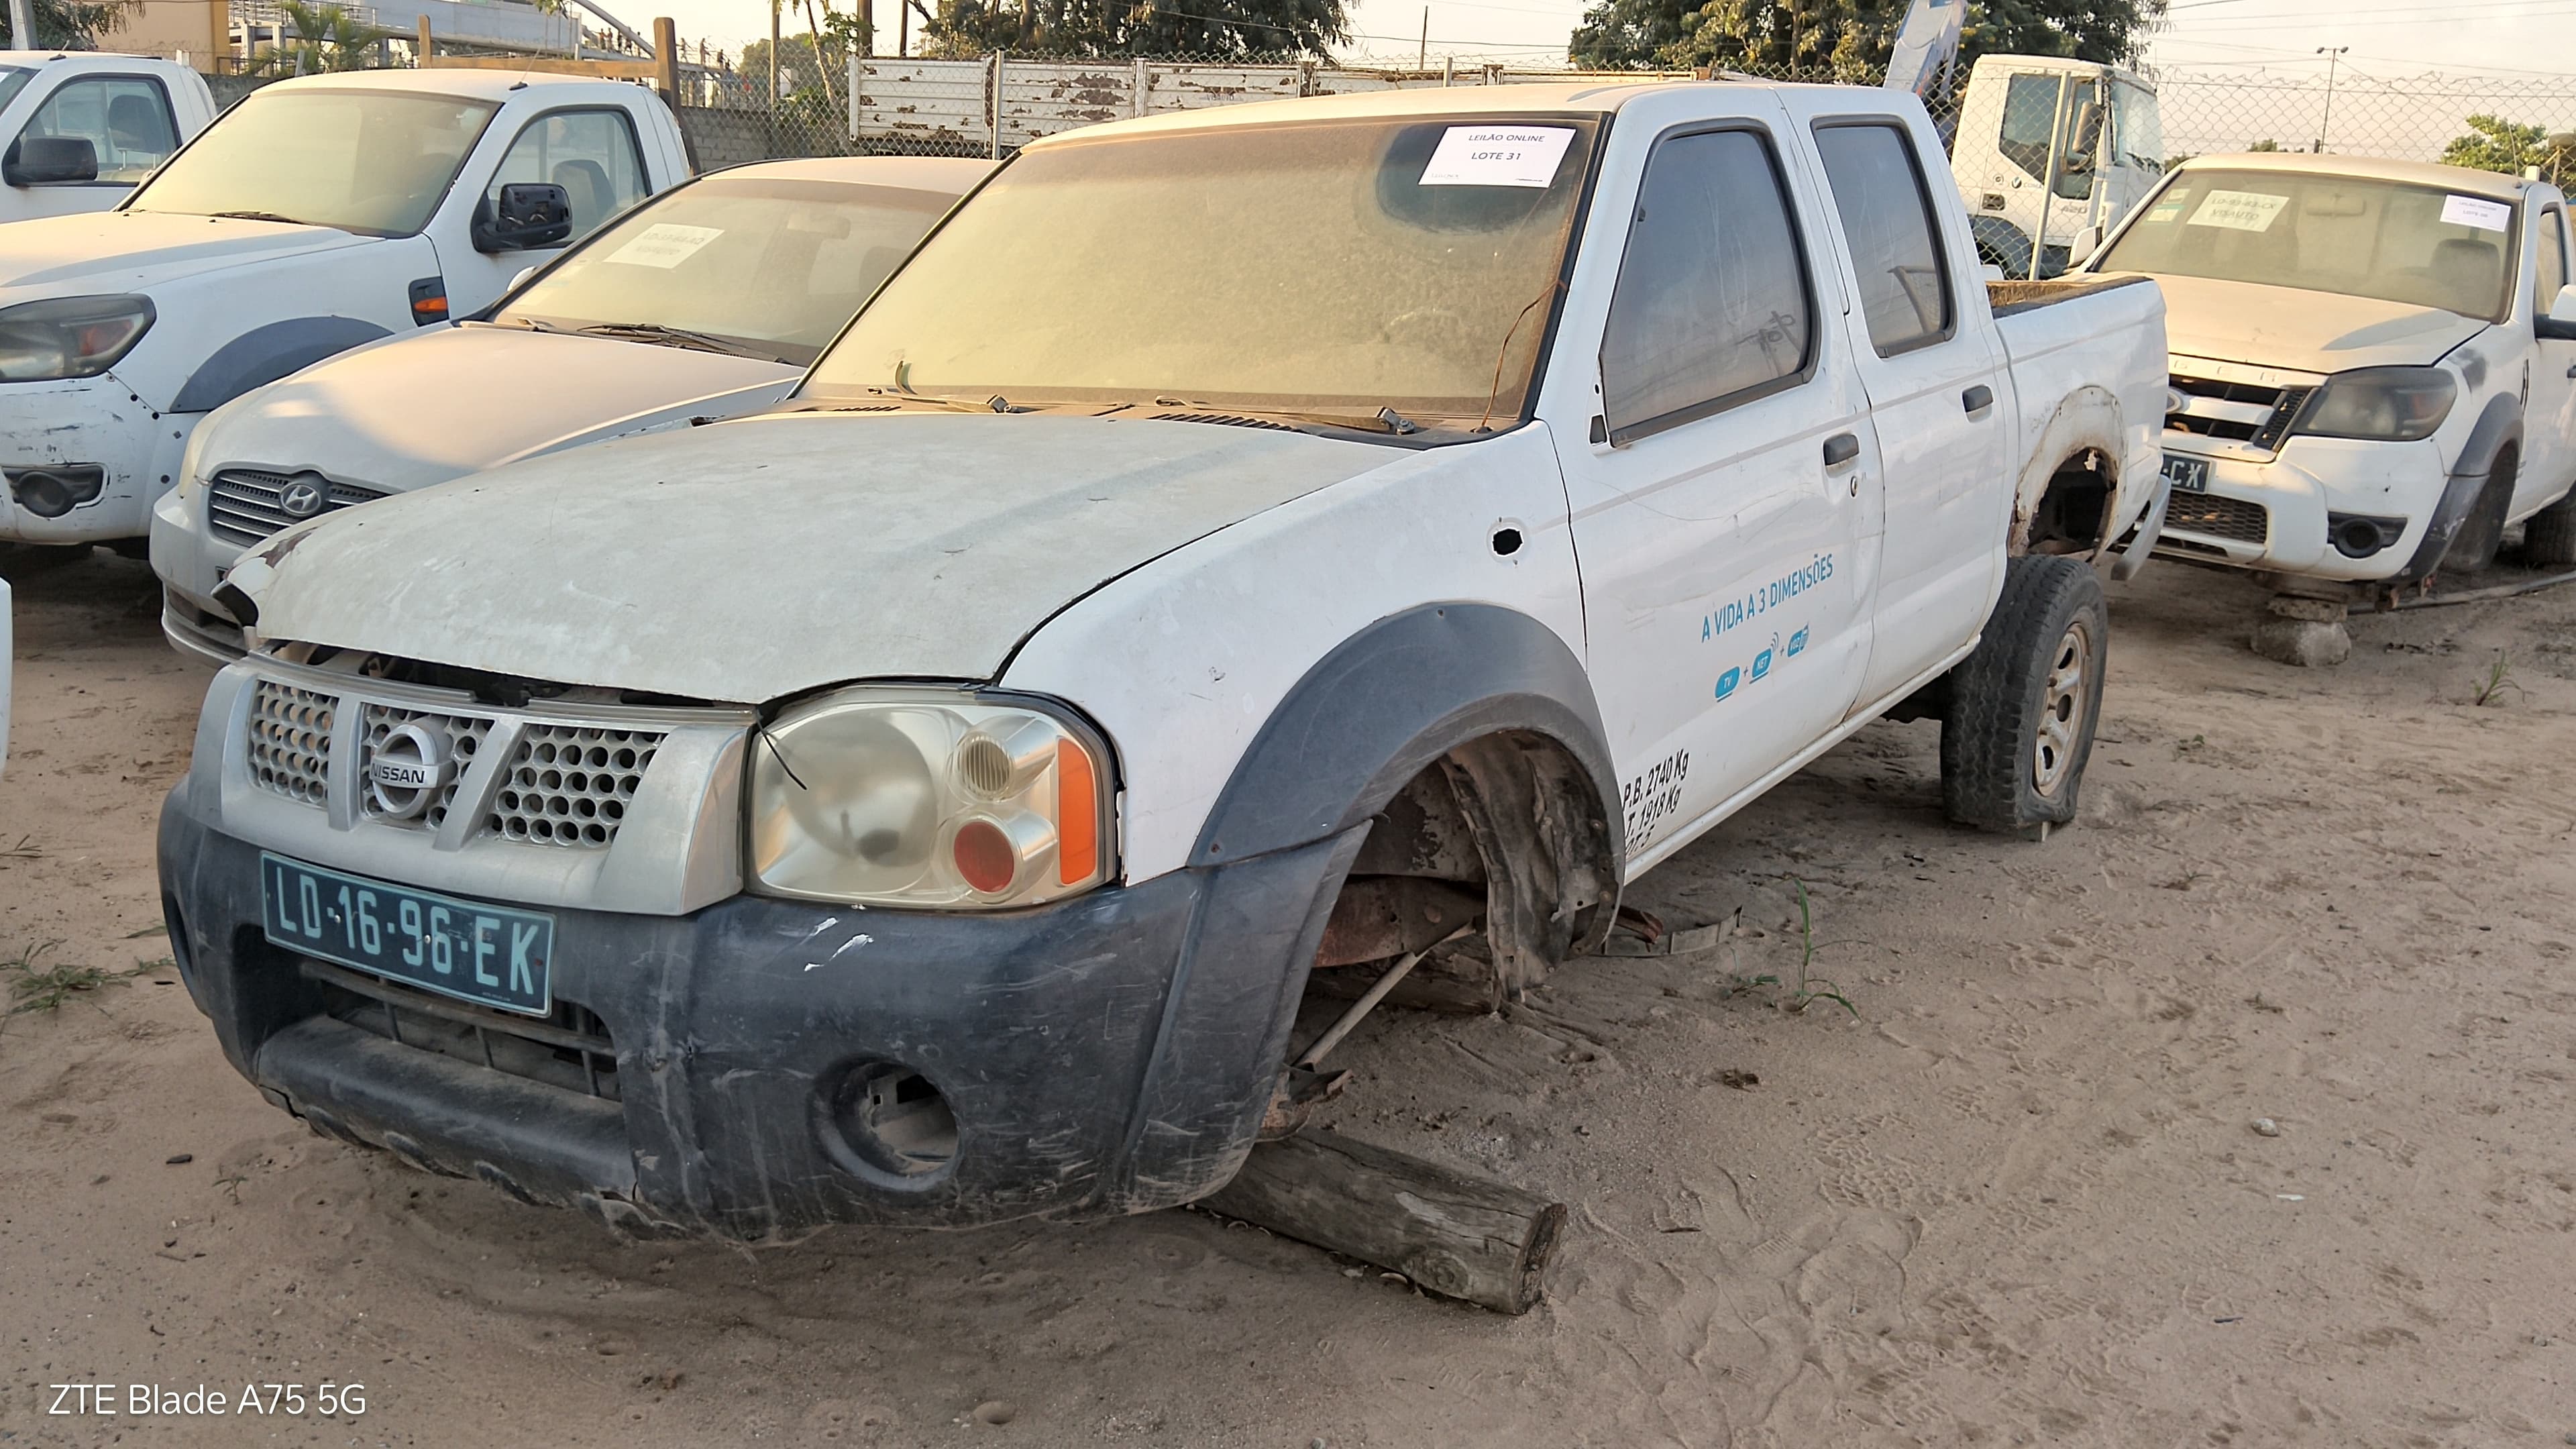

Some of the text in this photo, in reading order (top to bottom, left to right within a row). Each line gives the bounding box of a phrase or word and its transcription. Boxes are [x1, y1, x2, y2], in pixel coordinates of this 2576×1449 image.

[1468, 133, 1546, 142] LEILÃO ONLINE
[1471, 152, 1521, 160] LOTE 31
[1702, 553, 1833, 643] A VIDA A 3 DIMENSÕES
[371, 763, 425, 784] NISSAN
[1646, 755, 1673, 797] 2740
[1674, 748, 1689, 781] Kg
[1639, 792, 1666, 830] 1918
[1665, 784, 1682, 814] Kg
